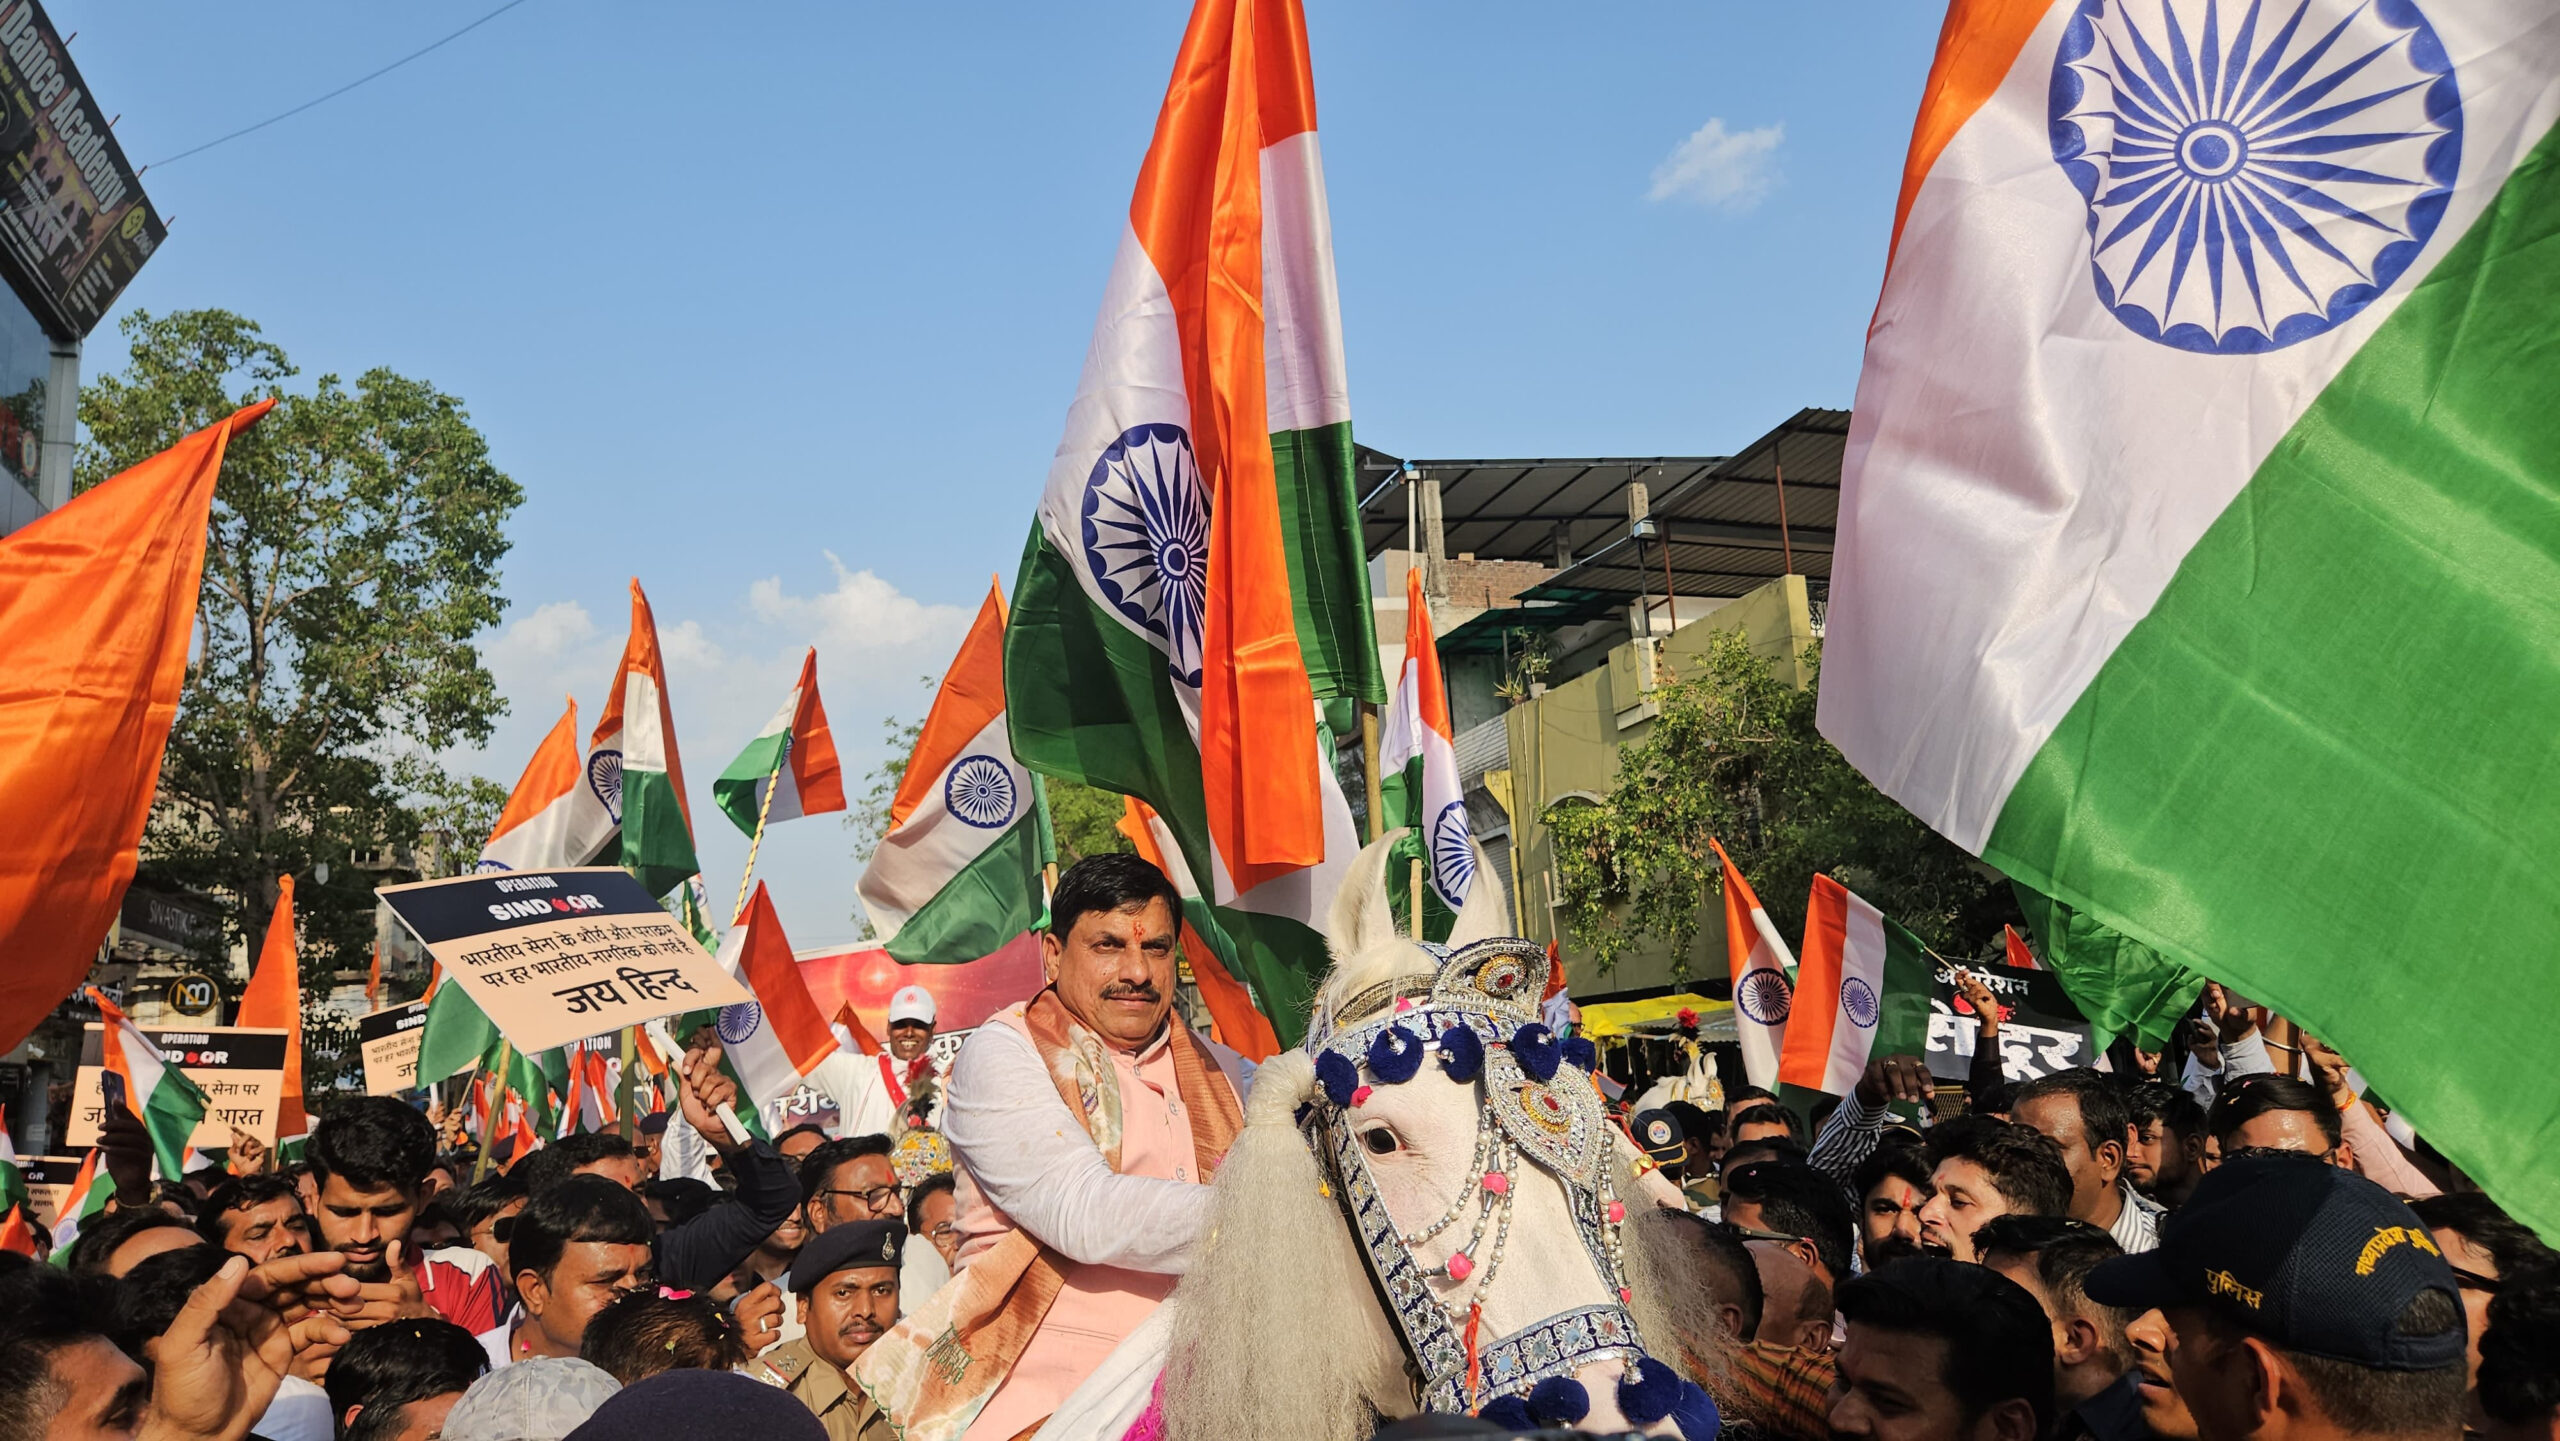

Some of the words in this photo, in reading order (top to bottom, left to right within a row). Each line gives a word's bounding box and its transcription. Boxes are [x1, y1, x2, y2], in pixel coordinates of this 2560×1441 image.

[1, 0, 65, 107] Dance
[49, 87, 128, 215] Academy
[495, 875, 558, 893] OPERATION
[460, 942, 526, 967] भारतीय
[522, 936, 556, 956] सेना
[553, 930, 577, 948] के
[579, 925, 607, 944] शौर्य
[607, 922, 632, 940] और
[633, 924, 677, 939] पराक्रम
[480, 970, 509, 988] पर
[506, 966, 532, 984] हर
[531, 951, 592, 977] भारतीय
[592, 943, 641, 965] नागरिक
[639, 940, 663, 957] को
[662, 938, 683, 955] गर्व
[677, 938, 694, 955] है
[552, 979, 627, 1014] जय
[616, 967, 698, 1001] हिन्द
[161, 1033, 209, 1045] OPERATION
[212, 1080, 238, 1095] सेना
[243, 1084, 260, 1095] पर
[216, 1108, 264, 1125] भारत
[2205, 1268, 2263, 1310] पुलिस
